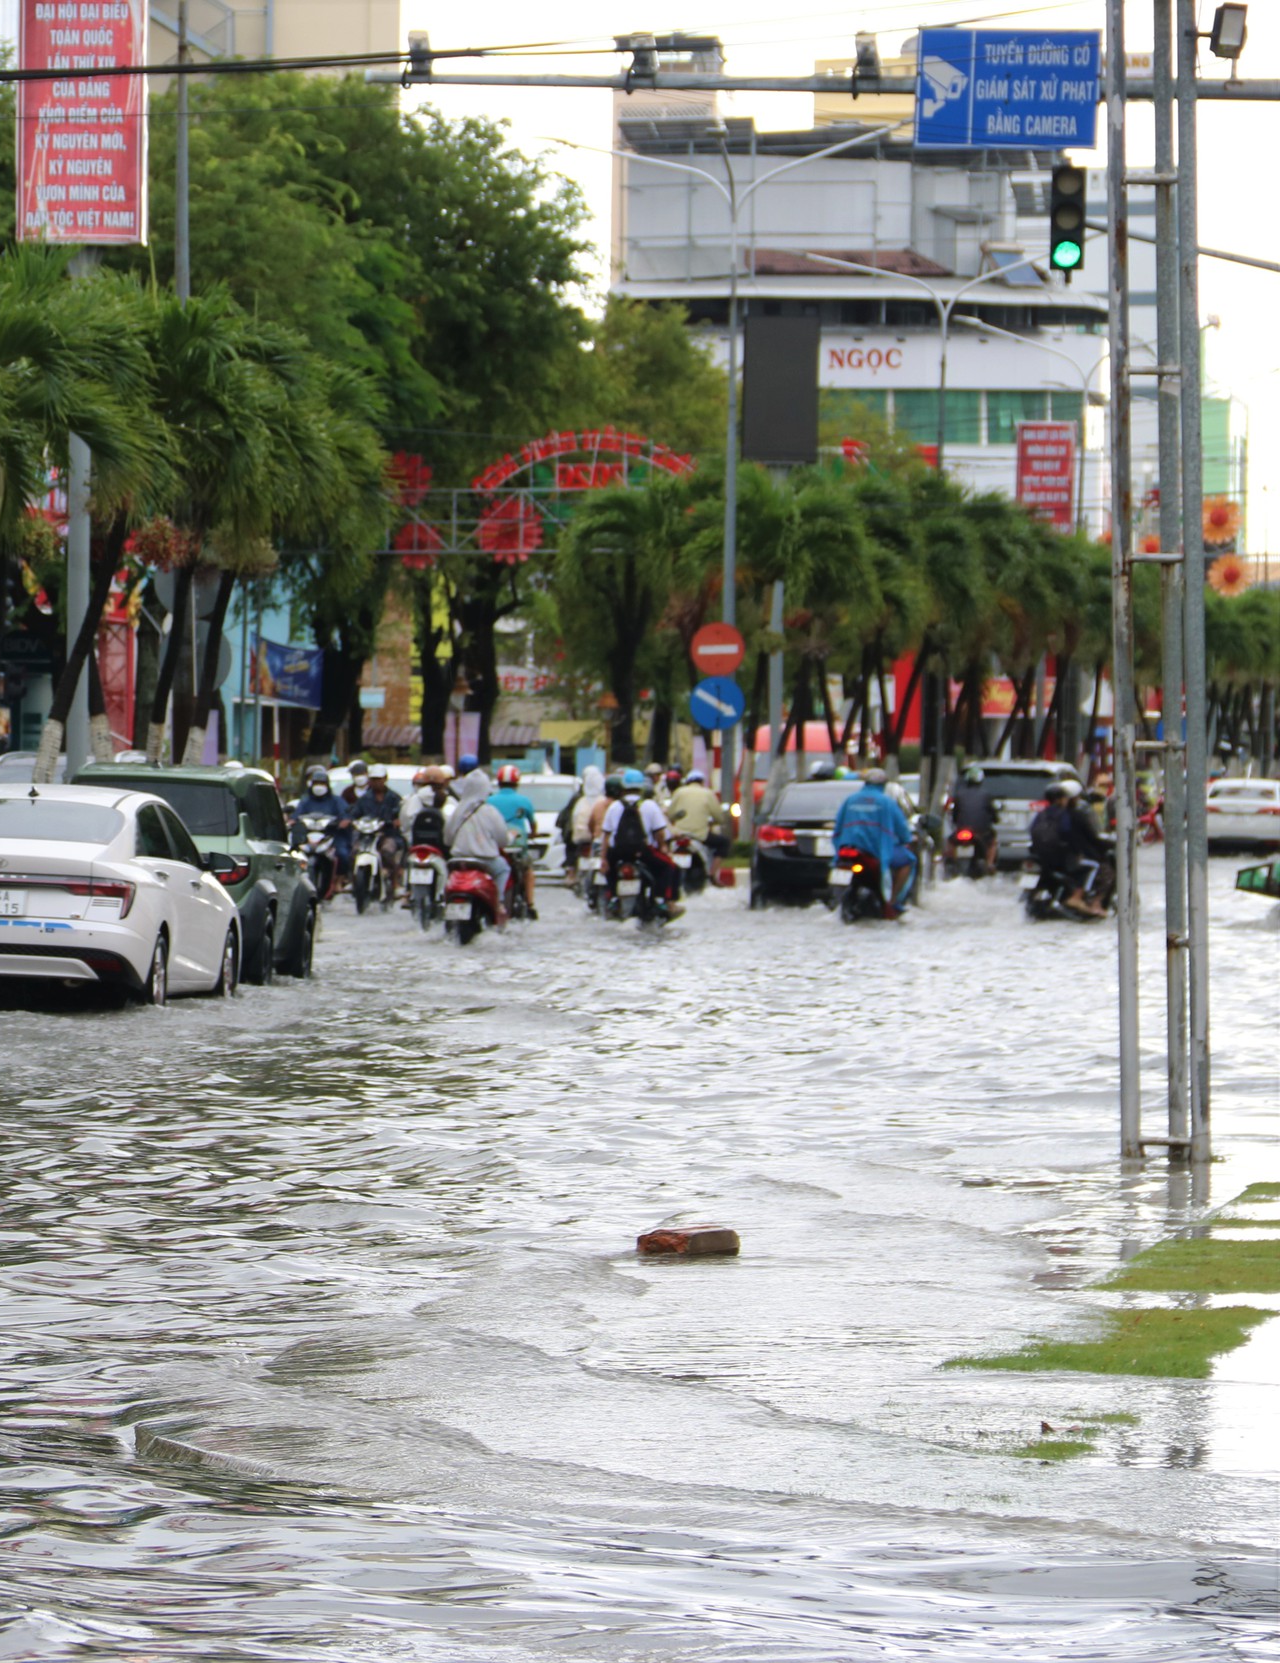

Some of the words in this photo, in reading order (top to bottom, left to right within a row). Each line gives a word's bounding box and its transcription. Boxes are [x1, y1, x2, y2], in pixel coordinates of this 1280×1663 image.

[36, 3, 55, 21] ĐẠI
[59, 2, 78, 21] HỘI
[80, 3, 100, 21] ĐẠI
[50, 25, 80, 45] TOÀN
[83, 24, 113, 46] QUỐC
[97, 55, 115, 69] XIV
[984, 37, 1023, 65] TUYẾN
[1028, 38, 1068, 65] ĐƯỜNG
[1074, 40, 1091, 66] CÓ
[52, 78, 76, 97] CỦA
[79, 77, 110, 97] ĐẢNG
[976, 75, 1008, 100] GIÁM
[1013, 75, 1037, 101] SÁT
[1040, 73, 1059, 101] XỬ
[1061, 80, 1095, 105] PHẠT
[100, 103, 124, 123] CỦA
[987, 107, 1020, 135] BẰNG
[1025, 115, 1077, 136] CAMERA
[52, 130, 98, 149] NGUYÊN
[67, 156, 112, 175] NGUYÊN
[69, 182, 99, 201] MÌNH
[102, 180, 126, 201] CỦA
[52, 207, 74, 230] TỘC
[76, 207, 101, 230] VIỆT
[103, 211, 134, 228] NAM!
[828, 348, 903, 375] NGỌC
